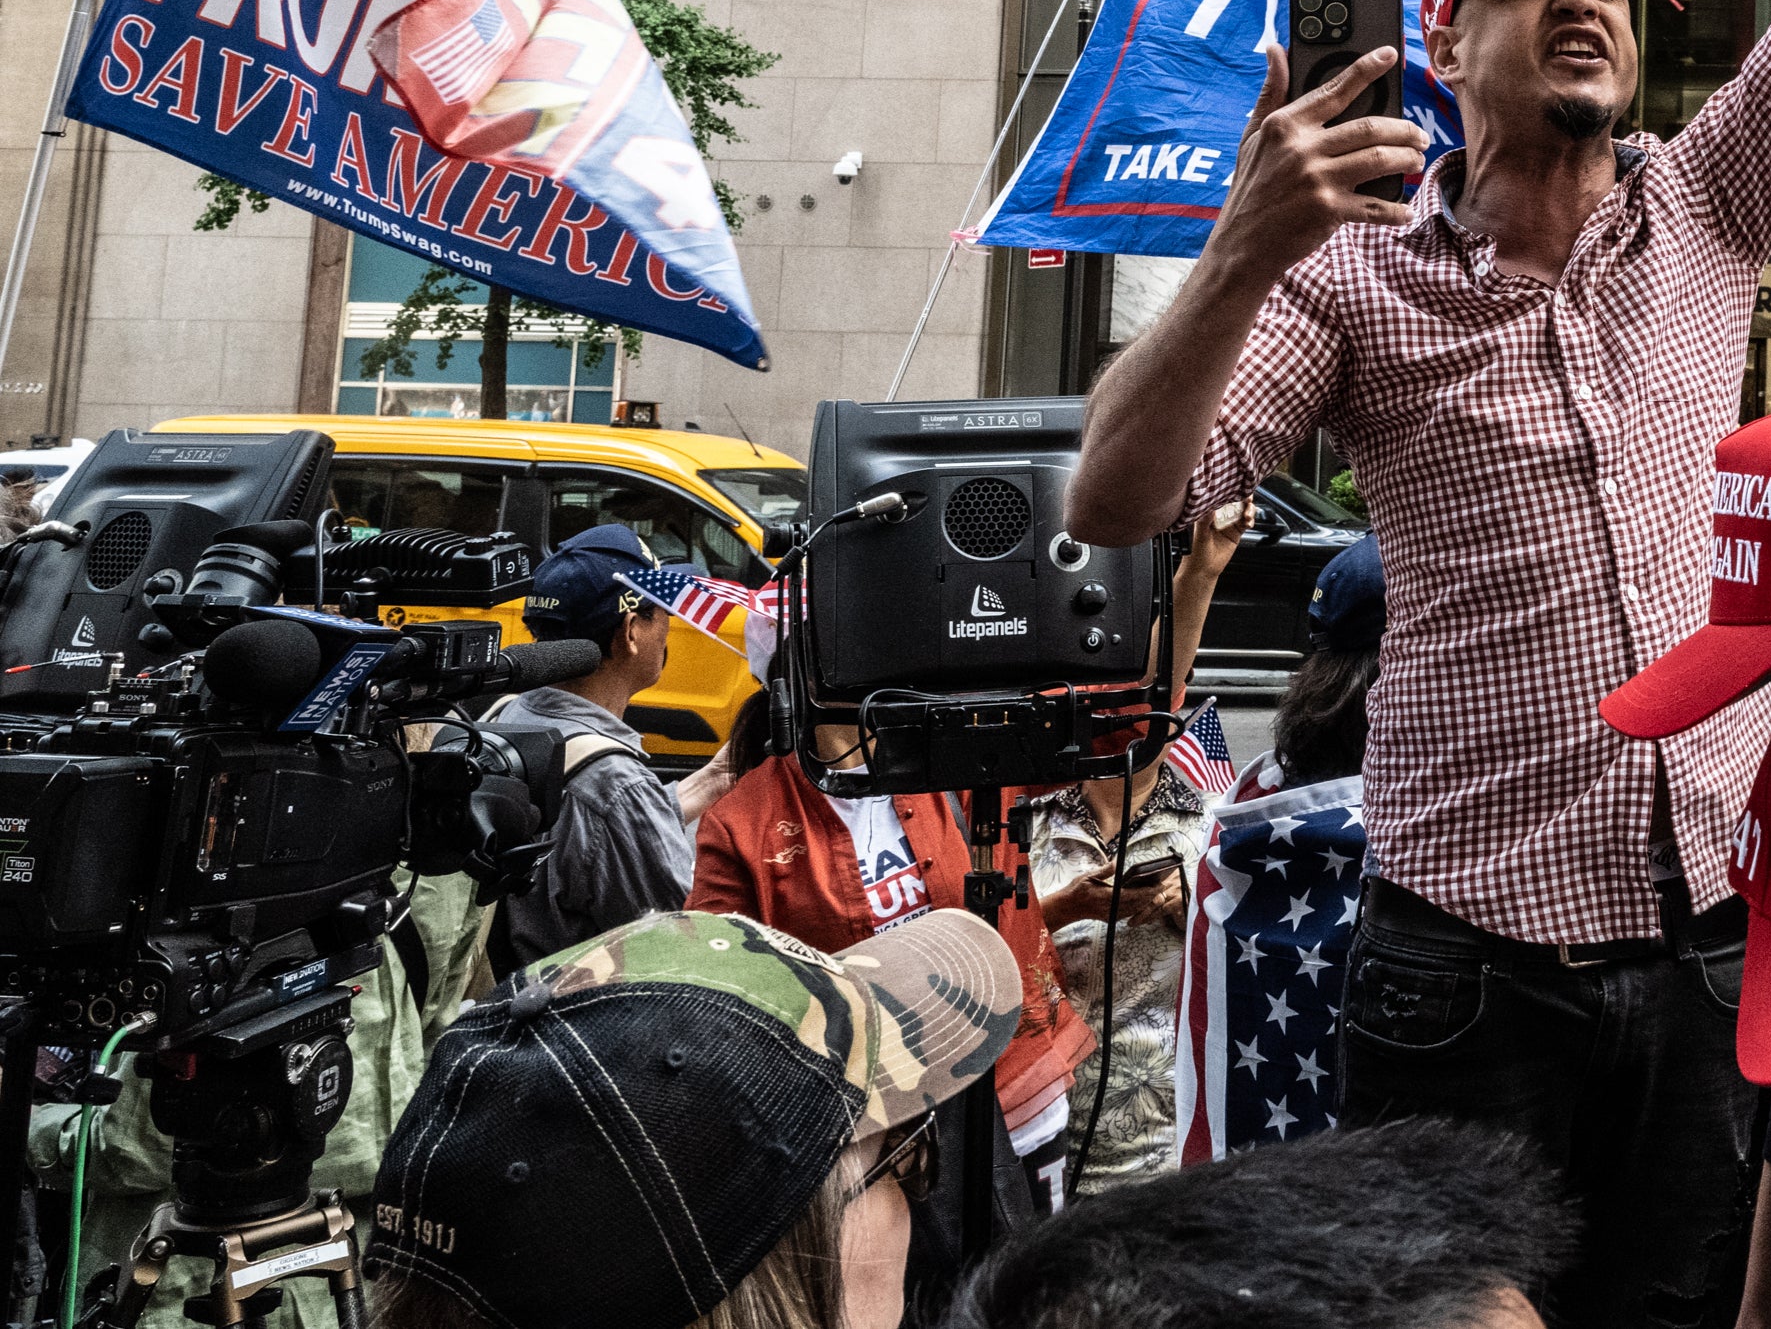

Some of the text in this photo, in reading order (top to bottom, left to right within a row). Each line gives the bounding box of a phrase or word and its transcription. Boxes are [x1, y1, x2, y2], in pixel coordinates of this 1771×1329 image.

[99, 13, 318, 168] SAVE
[331, 111, 728, 313] AMERIC
[1103, 144, 1222, 183] TAKE
[287, 176, 494, 276] www.TrumpSwag.com
[964, 415, 1020, 427] ASTRA
[175, 449, 214, 461] ASTRA
[527, 595, 560, 610] RUMP
[948, 616, 1028, 641] Litepanels
[485, 634, 494, 663] SONY
[298, 656, 364, 719] NEWS
[312, 656, 377, 719] NATION
[118, 693, 150, 702] SONY
[367, 776, 395, 793] SONY
[0, 817, 29, 826] NTON
[0, 825, 26, 833] AUER
[2, 870, 33, 883] 240
[314, 1095, 340, 1116] OZEN
